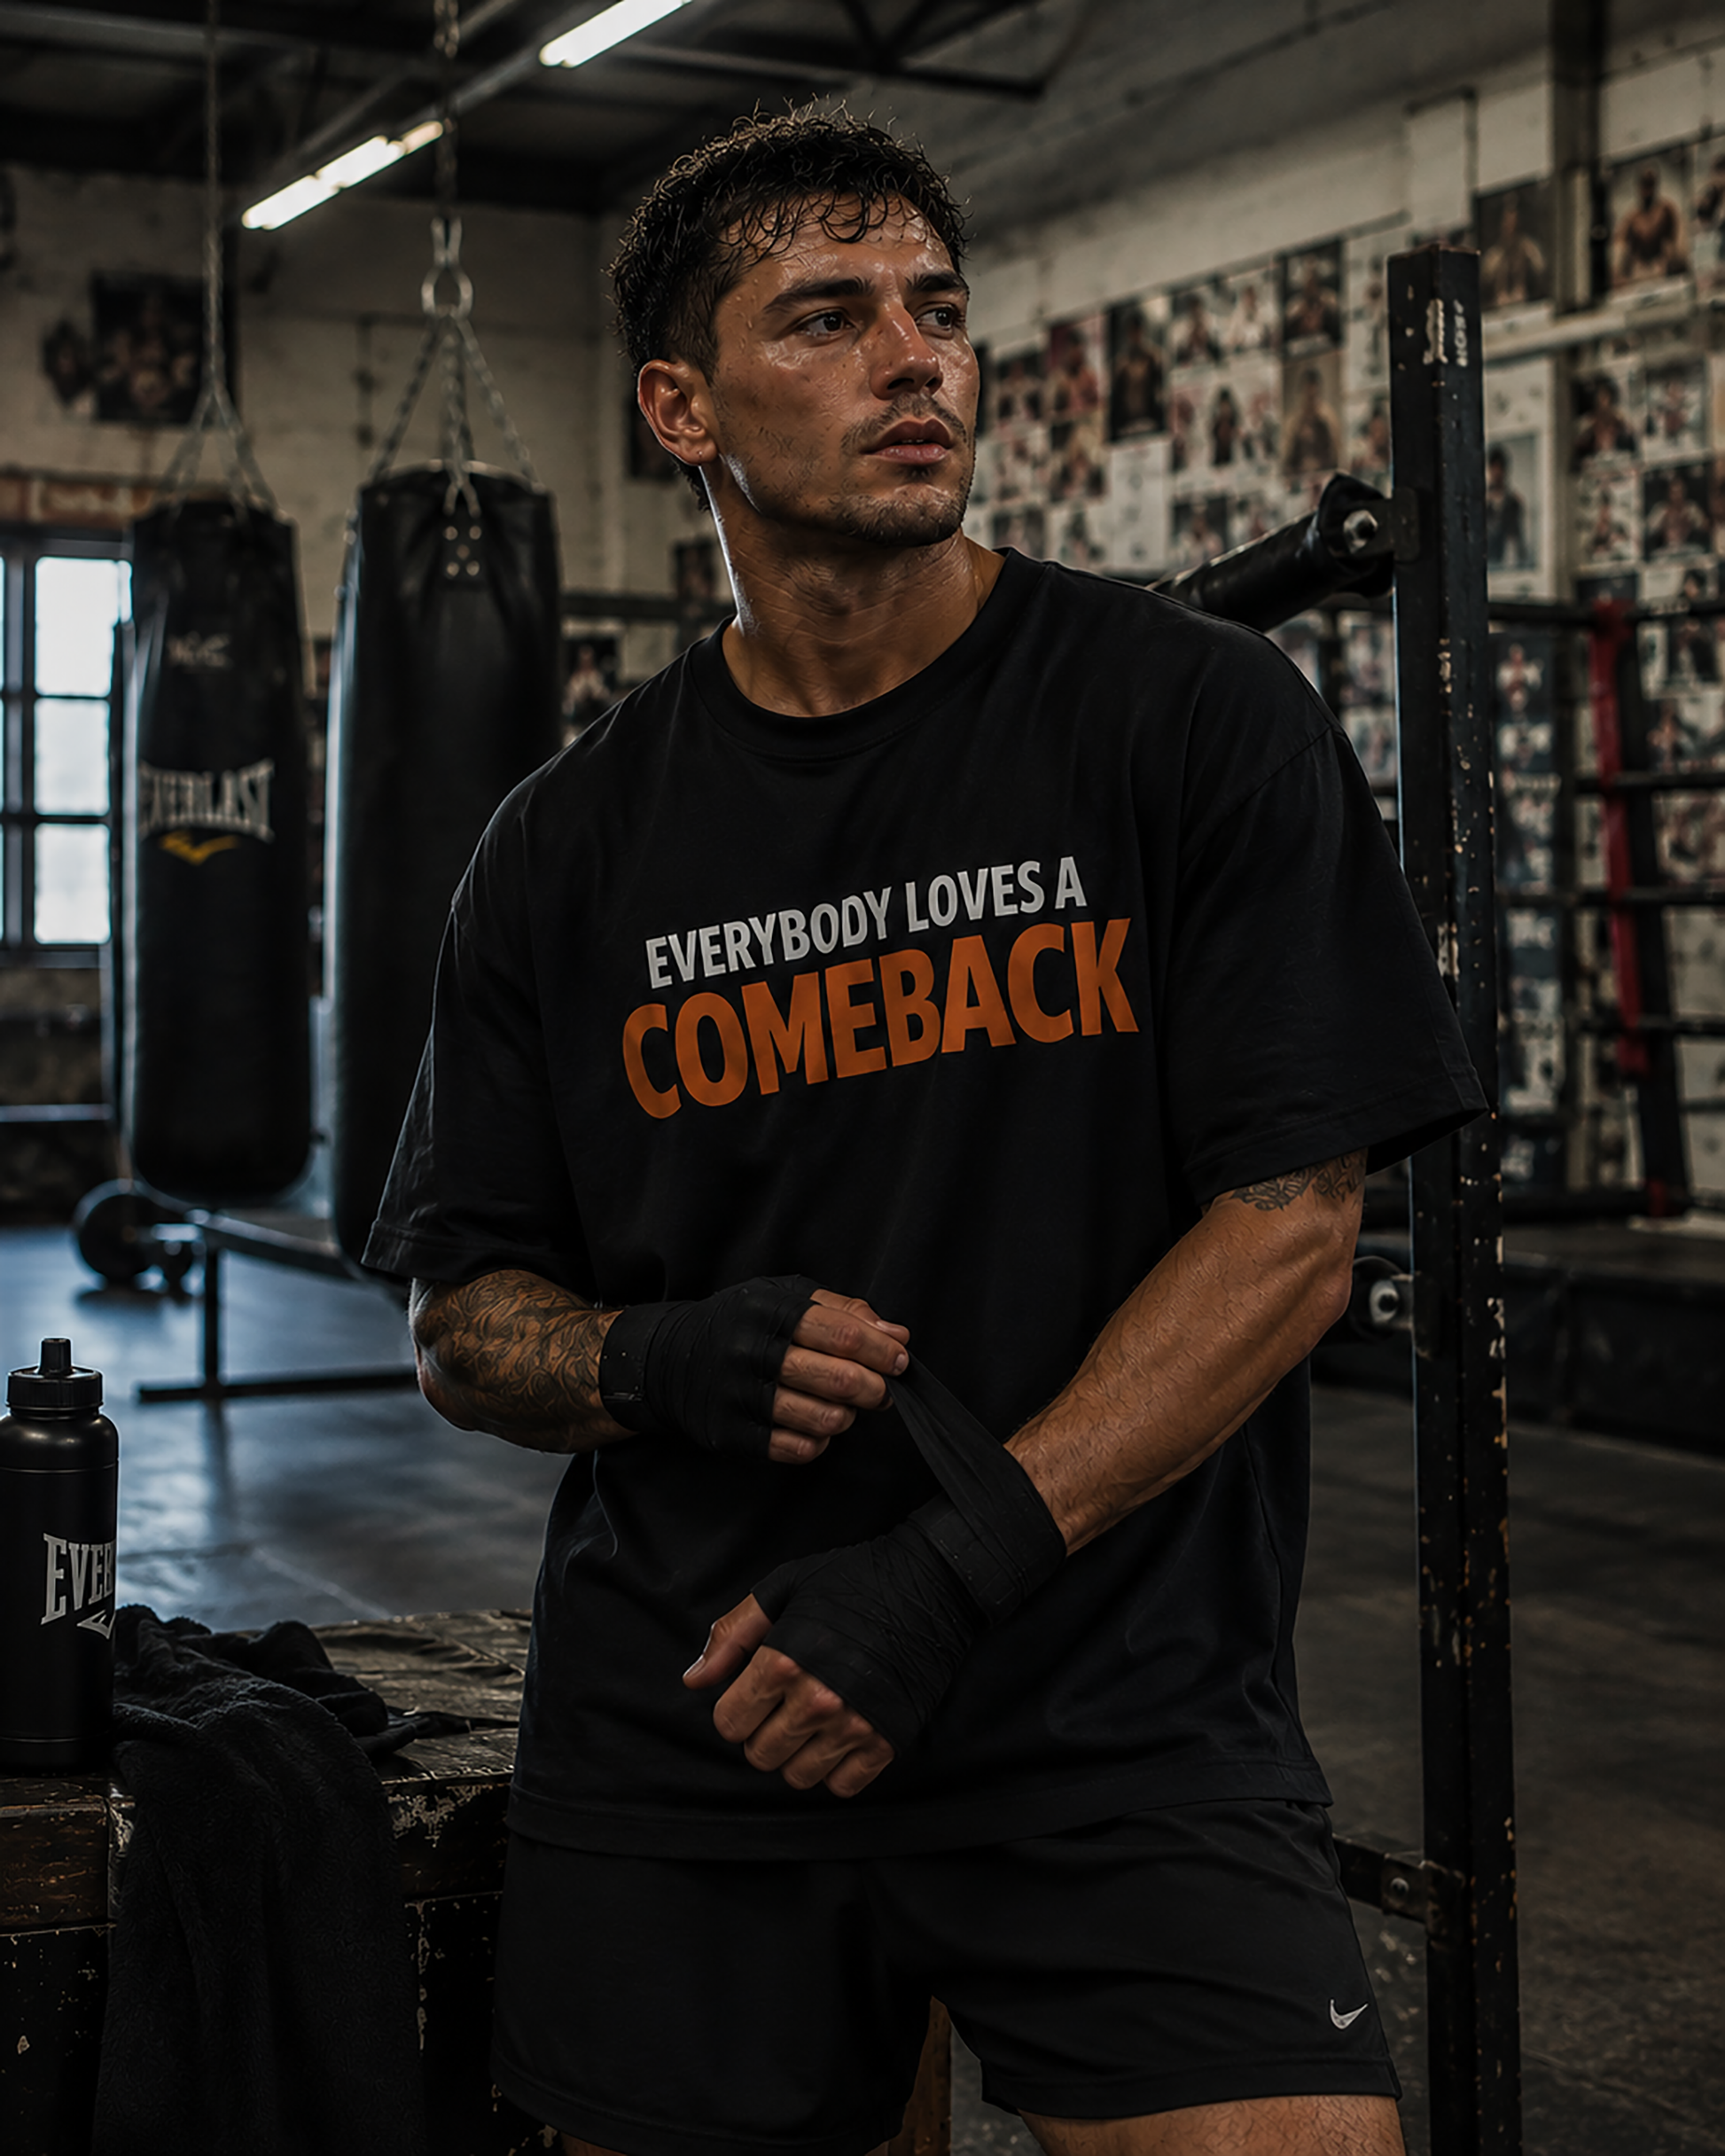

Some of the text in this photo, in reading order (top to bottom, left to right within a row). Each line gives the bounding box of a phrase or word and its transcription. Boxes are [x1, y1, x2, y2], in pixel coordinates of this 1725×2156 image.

[645, 856, 1089, 991] EVERYBODY LOVES A
[622, 918, 1140, 1121] COMEBACK
